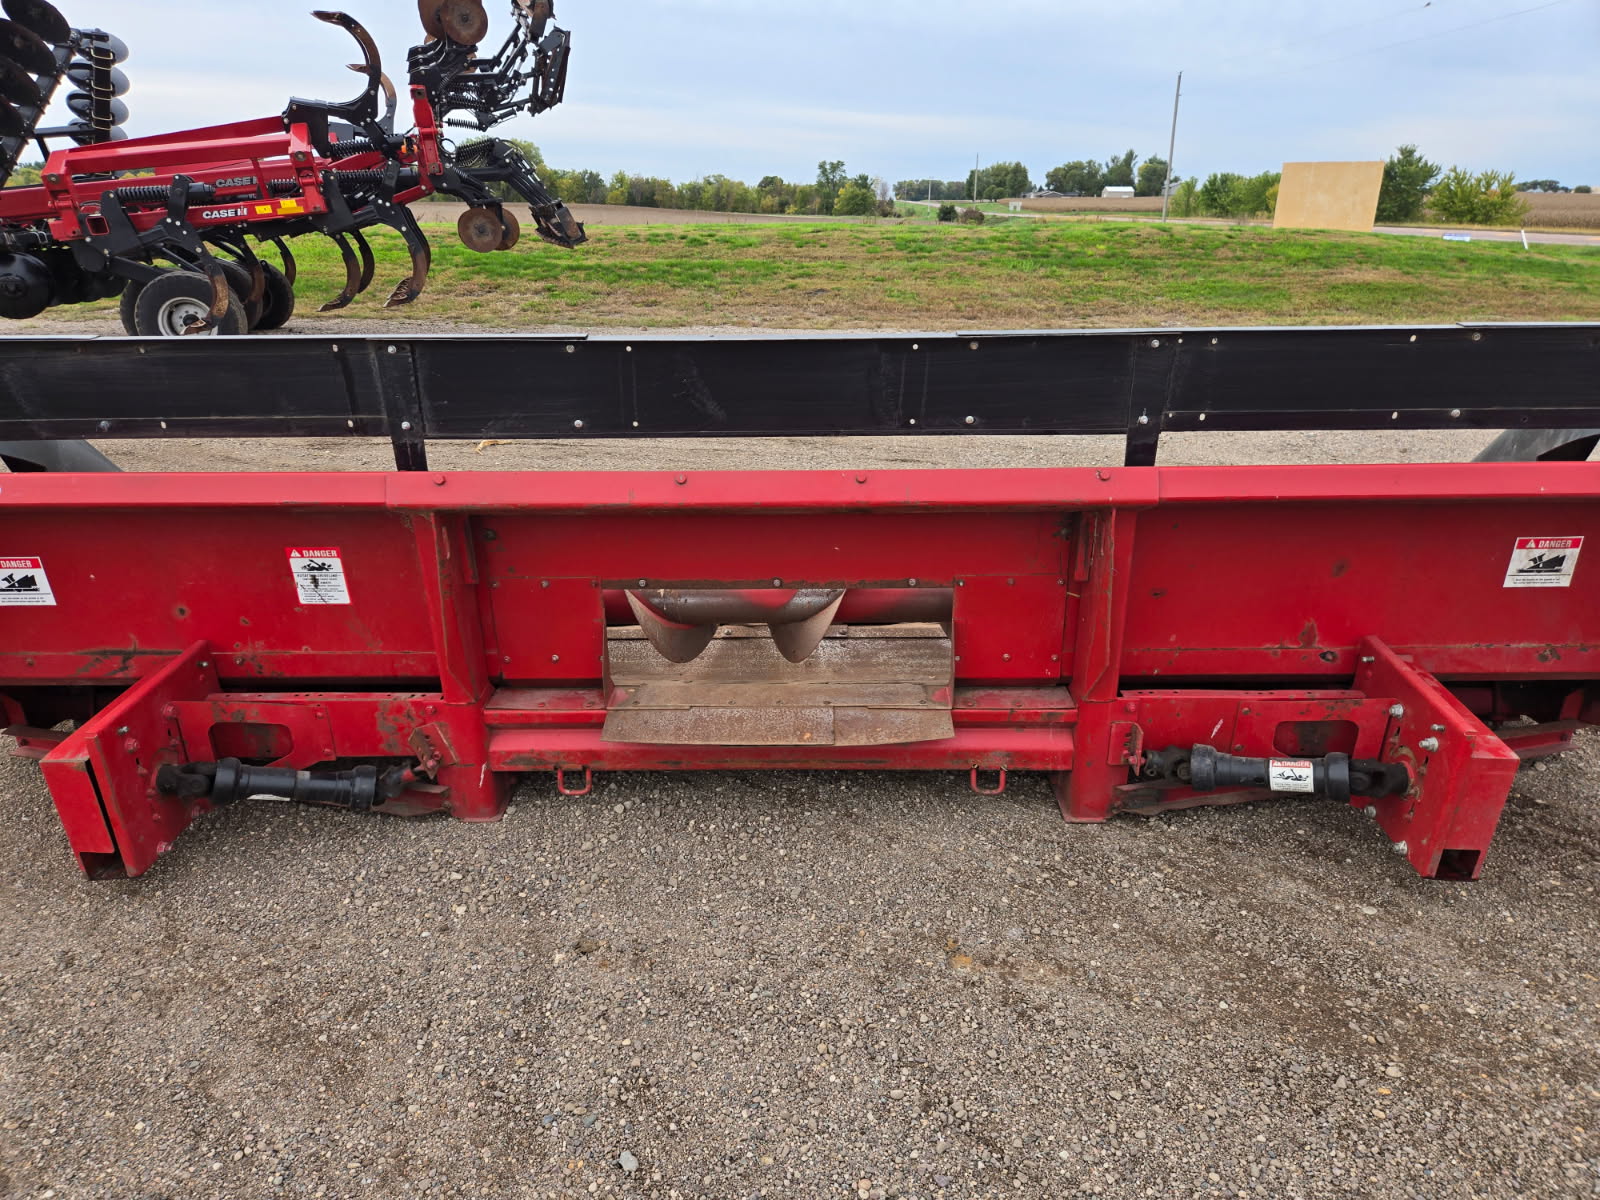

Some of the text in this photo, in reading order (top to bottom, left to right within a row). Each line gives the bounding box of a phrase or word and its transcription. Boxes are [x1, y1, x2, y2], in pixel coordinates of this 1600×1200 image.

[216, 177, 251, 187] CASE
[202, 208, 235, 219] CASE
[1538, 540, 1572, 548] DANGER
[0, 560, 32, 568] DANGER
